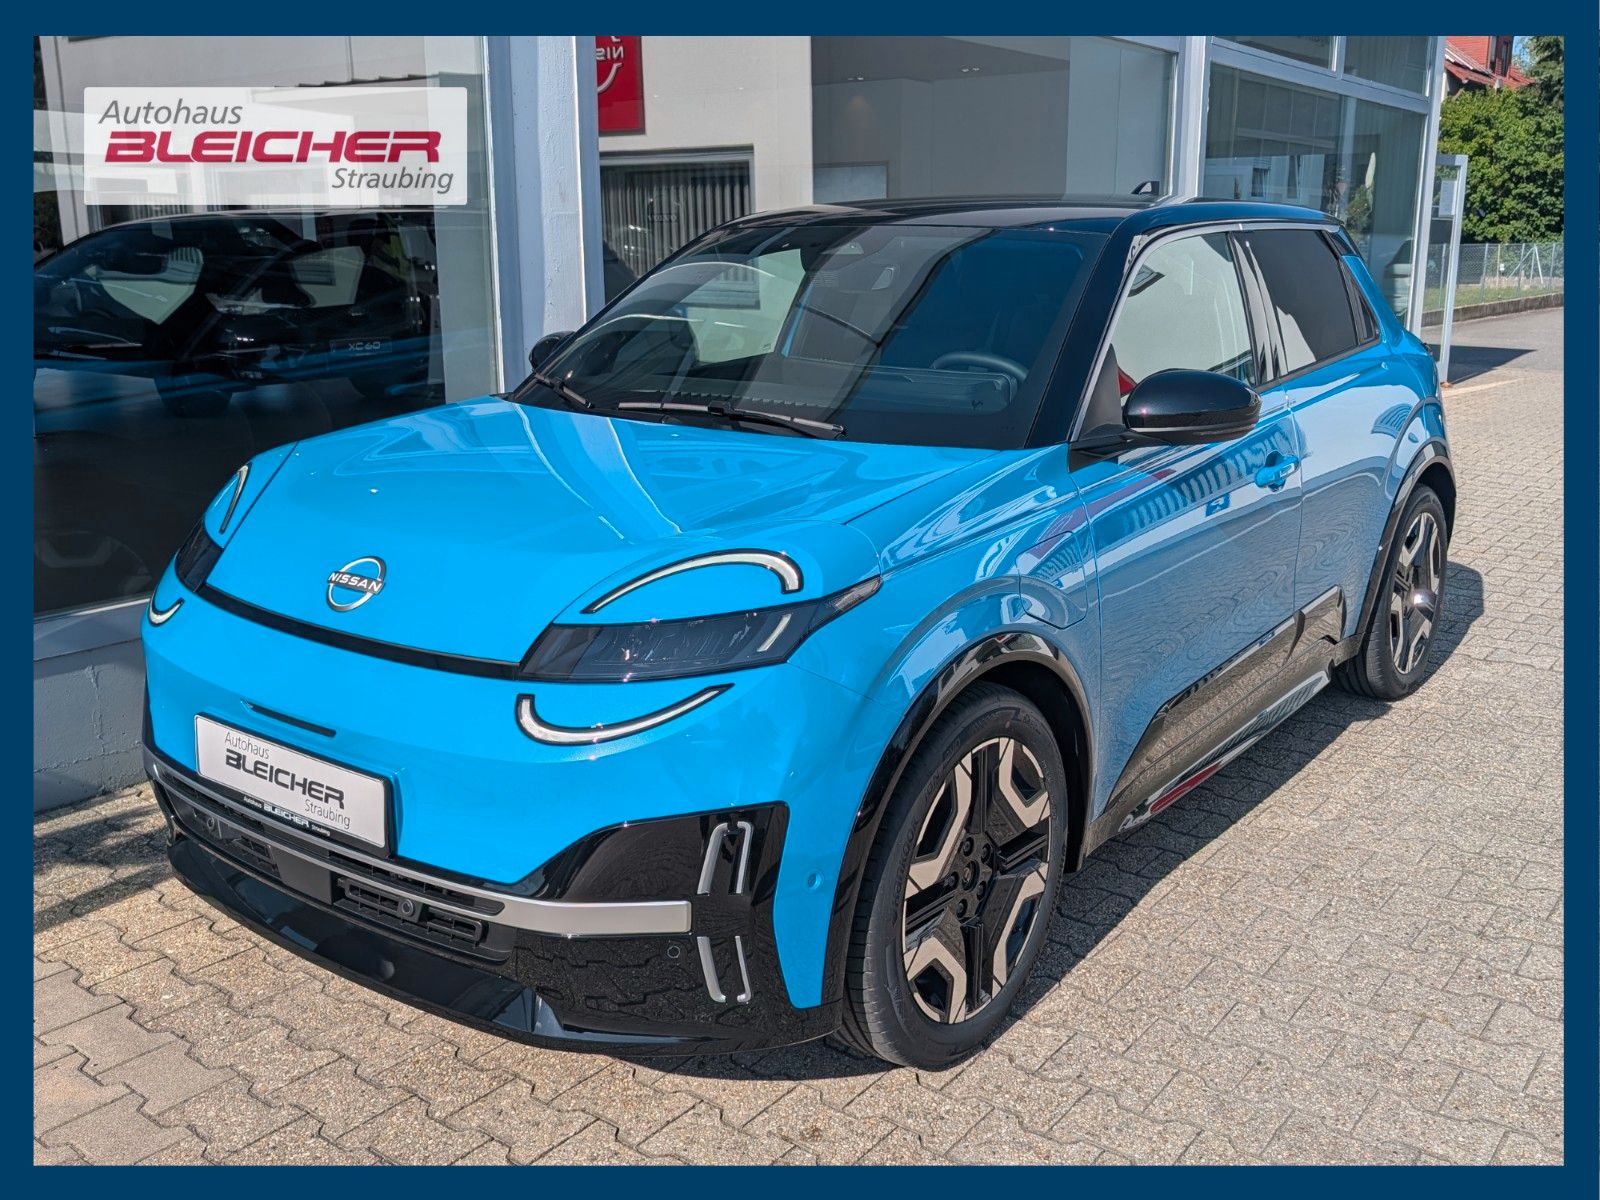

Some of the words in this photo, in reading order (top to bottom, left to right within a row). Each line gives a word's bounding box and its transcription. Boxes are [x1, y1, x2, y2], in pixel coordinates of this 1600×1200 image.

[328, 572, 382, 592] NISSAN
[224, 731, 270, 759] Autohaus
[225, 748, 345, 810] BLEICHER
[304, 798, 351, 830] Straubing
